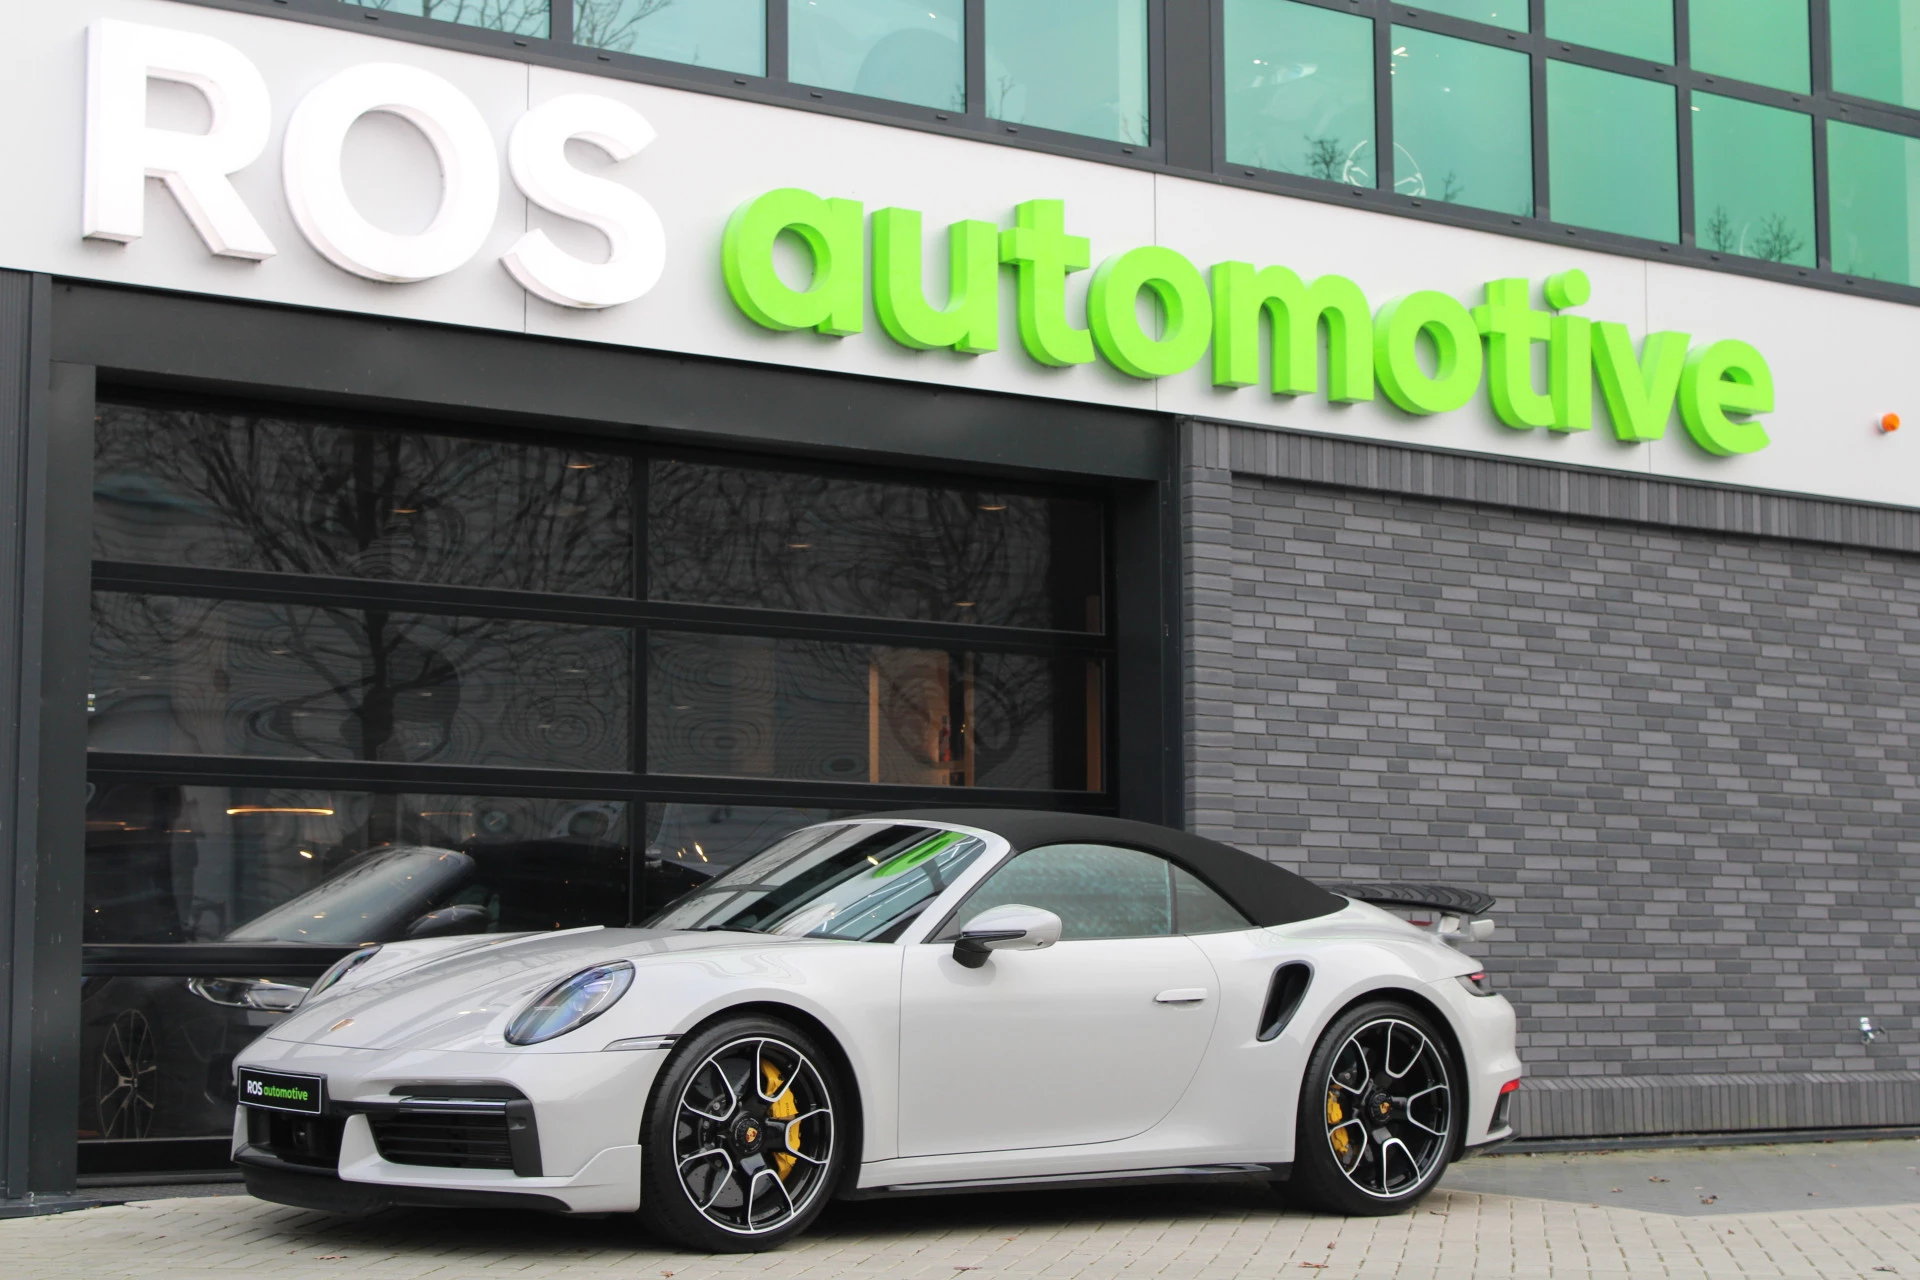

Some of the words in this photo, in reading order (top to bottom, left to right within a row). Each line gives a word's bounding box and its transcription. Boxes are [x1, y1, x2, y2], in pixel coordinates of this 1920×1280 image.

[83, 19, 666, 309] ROS
[721, 187, 1774, 456] automotive
[247, 1080, 262, 1095] ROS
[264, 1086, 308, 1100] automotive
